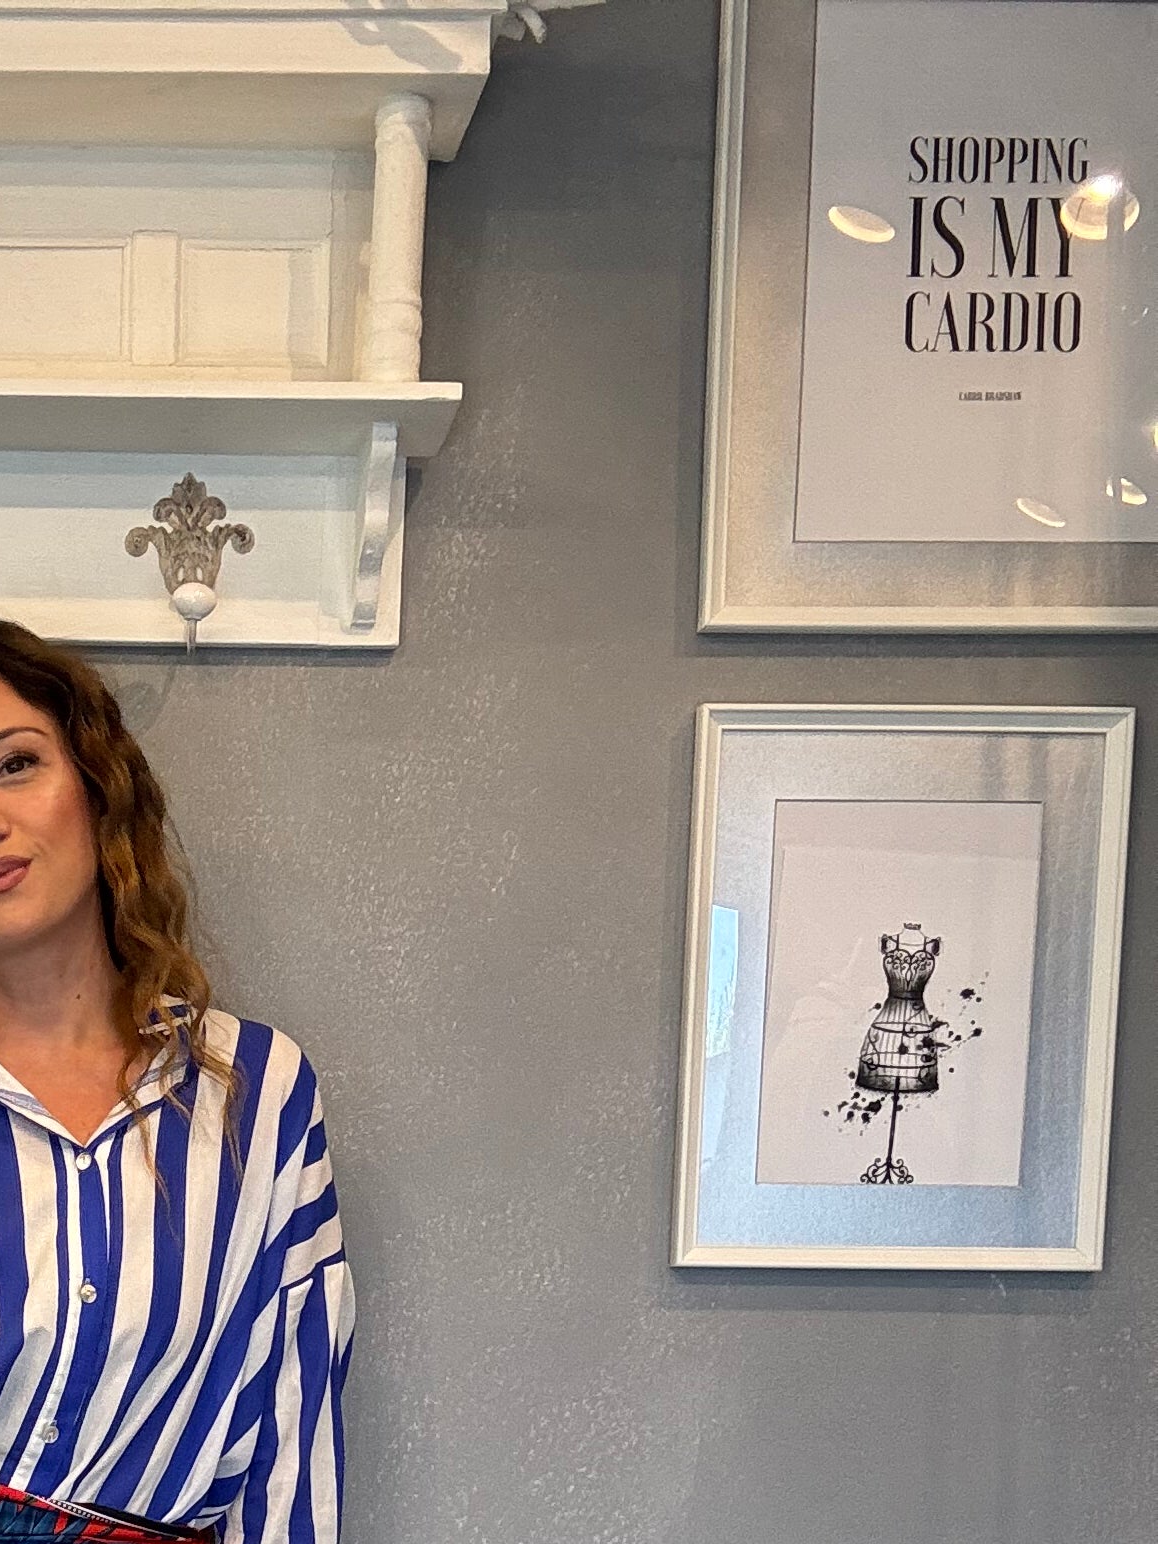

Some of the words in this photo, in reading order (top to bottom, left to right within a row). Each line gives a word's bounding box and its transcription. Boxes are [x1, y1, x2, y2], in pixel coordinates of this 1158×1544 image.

[908, 136, 1091, 184] SHOPPING
[906, 196, 965, 278] IS
[987, 197, 1087, 278] MY
[904, 291, 1082, 353] CARDIO
